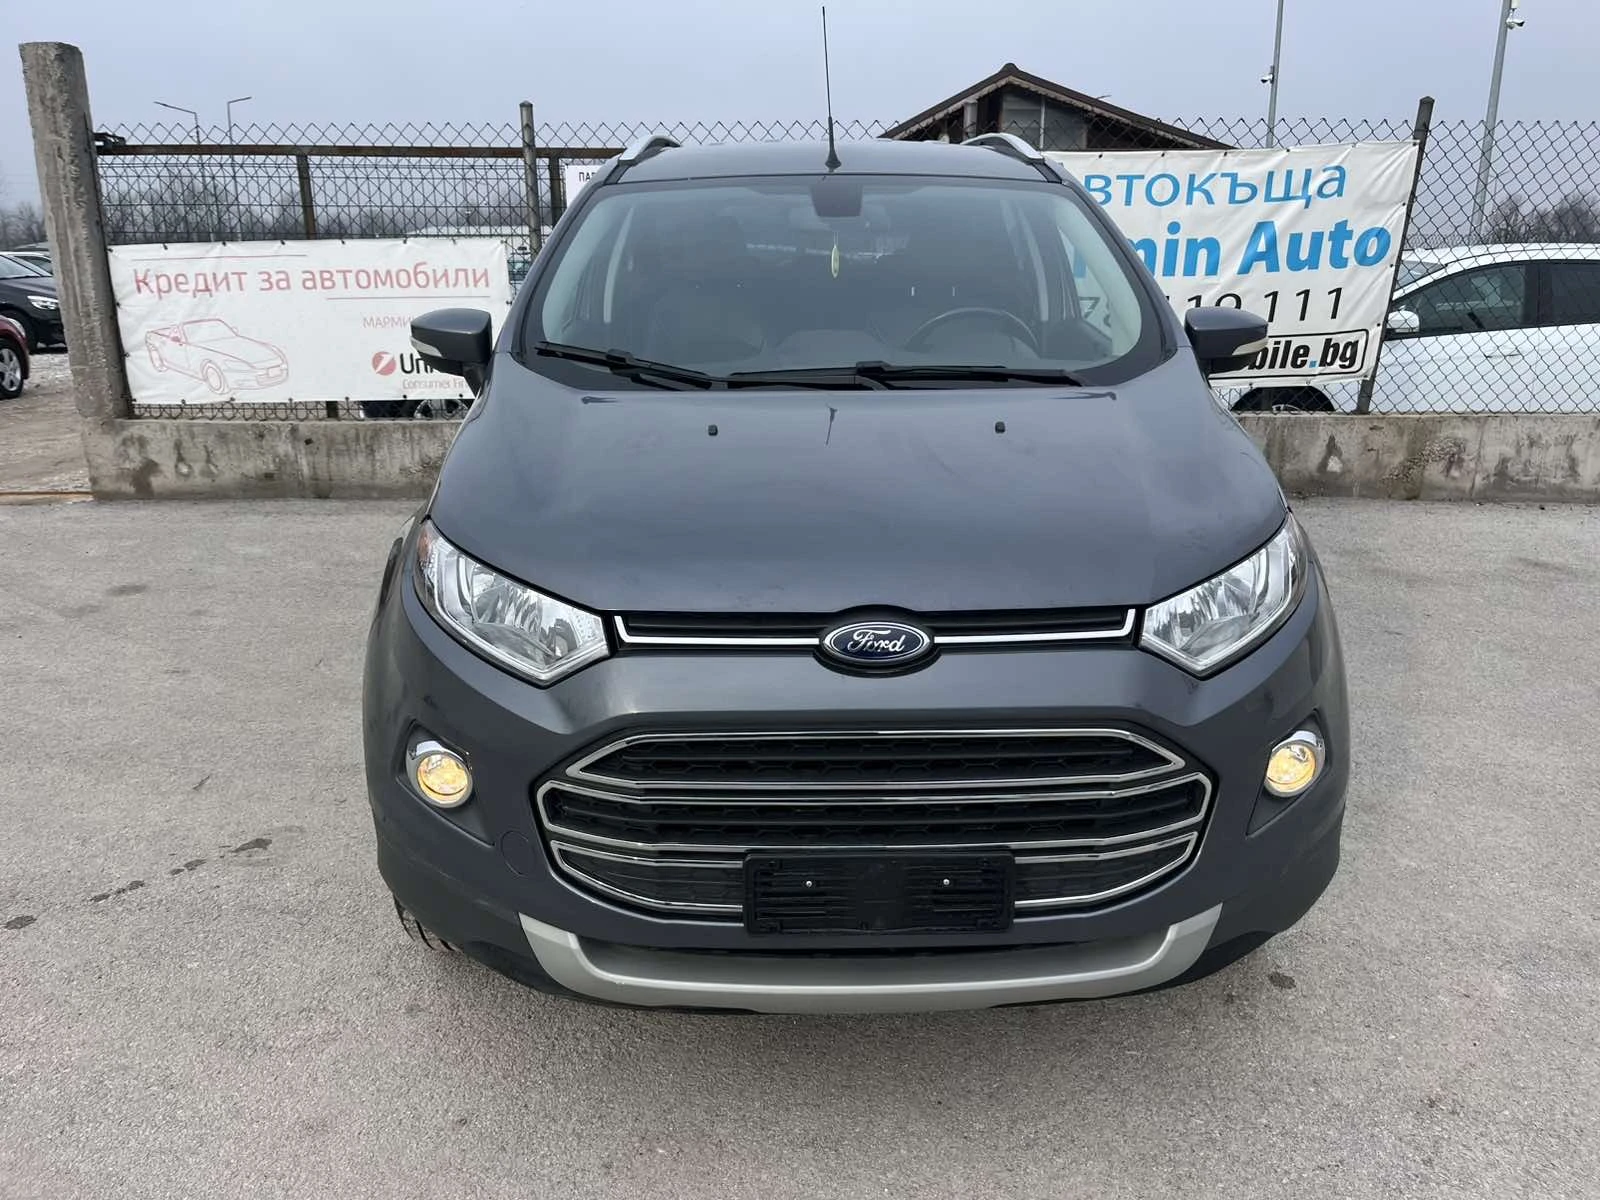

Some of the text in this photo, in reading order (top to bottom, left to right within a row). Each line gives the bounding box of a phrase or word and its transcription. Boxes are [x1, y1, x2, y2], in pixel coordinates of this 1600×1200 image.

[578, 171, 596, 182] ПА
[1084, 163, 1347, 209] втокъща
[1237, 218, 1391, 275] Auto
[134, 262, 490, 299] Кредит за автомобили
[1248, 337, 1360, 370] bile.bg
[847, 629, 906, 652] Ford
